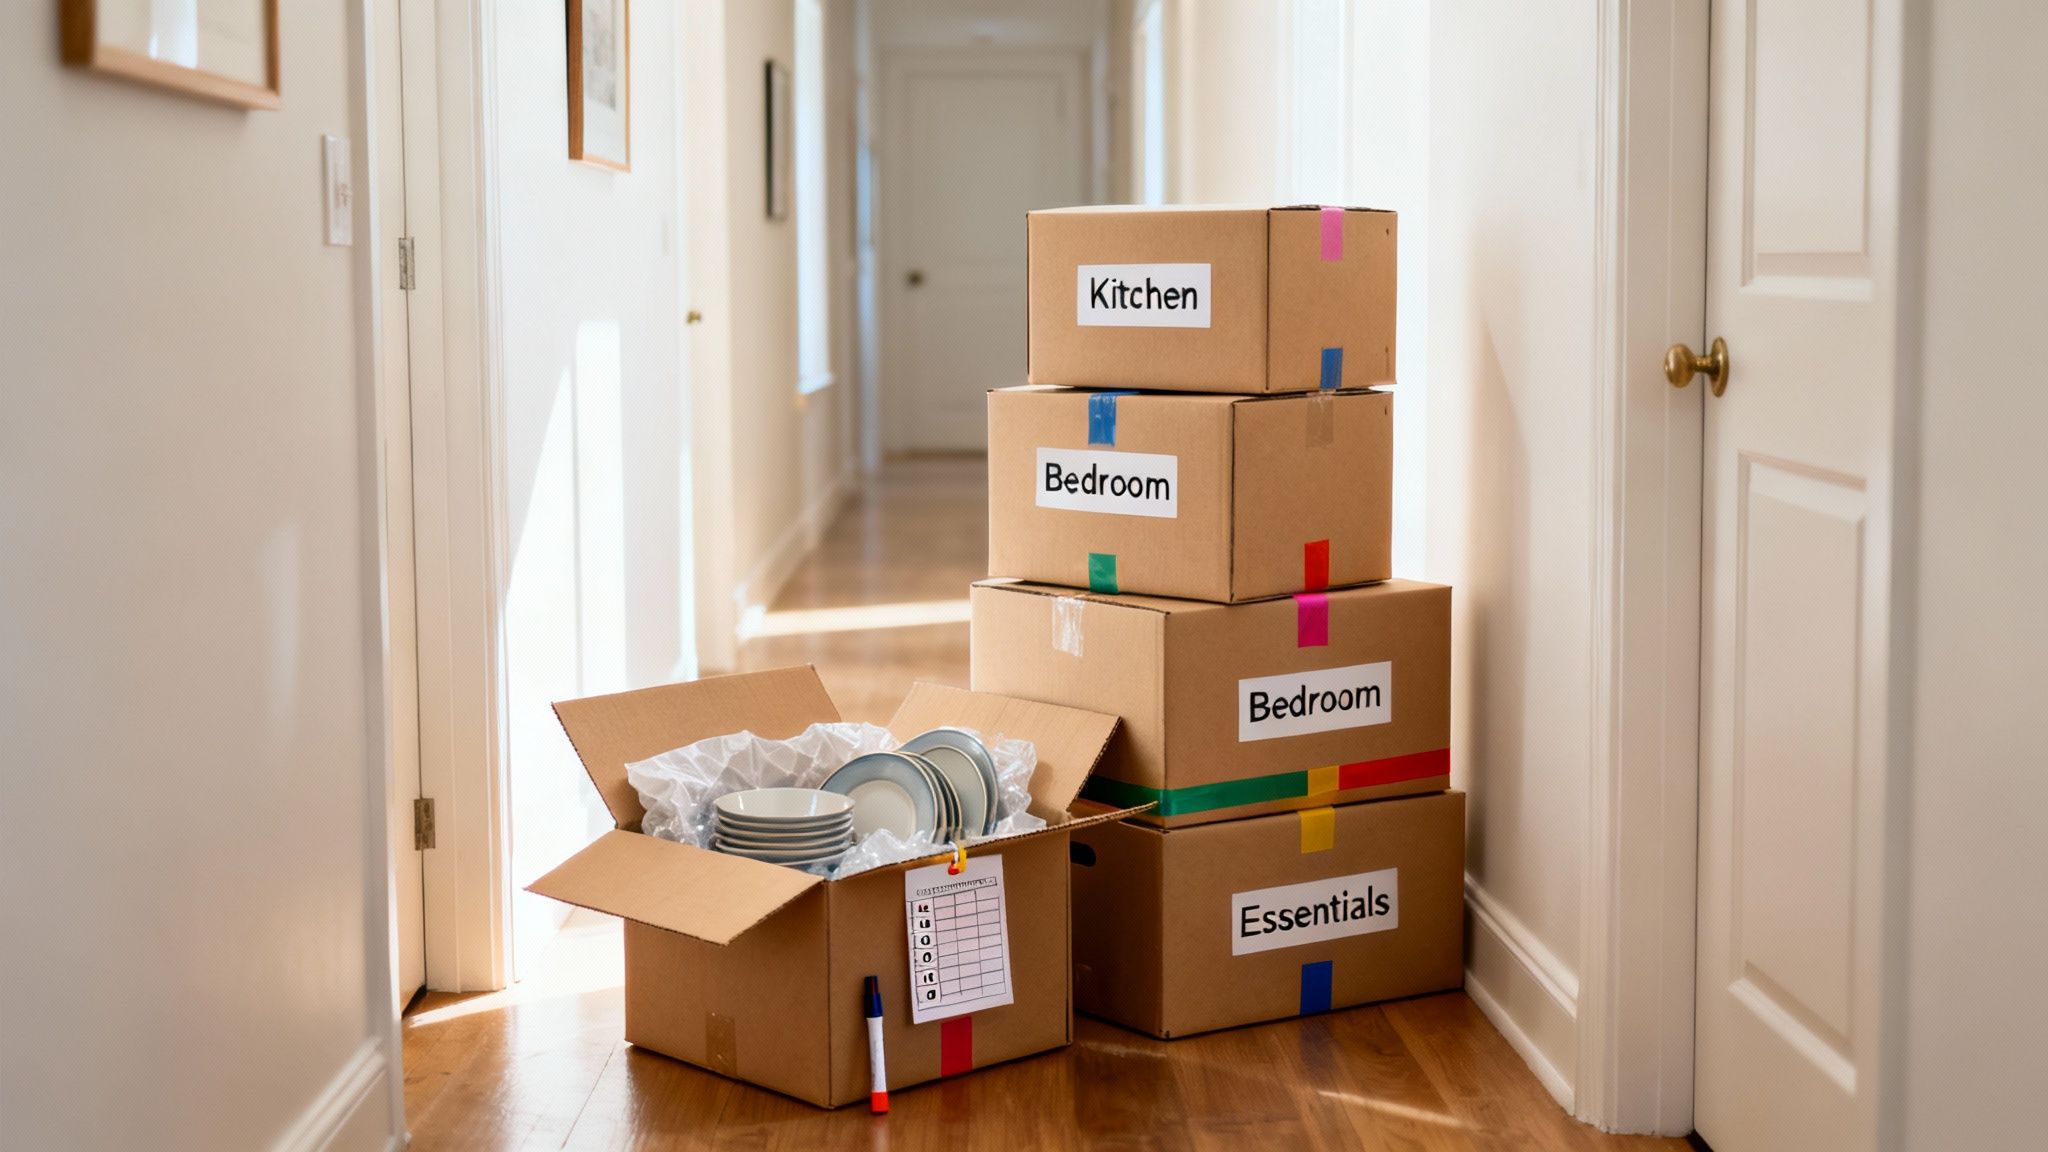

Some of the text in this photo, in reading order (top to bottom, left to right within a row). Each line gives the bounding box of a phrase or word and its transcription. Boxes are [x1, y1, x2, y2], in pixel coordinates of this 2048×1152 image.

[1090, 277, 1198, 310] Kitchen
[1045, 462, 1170, 501] Bedroom
[1249, 684, 1381, 723] Bedroom
[1240, 884, 1391, 938] Essentials
